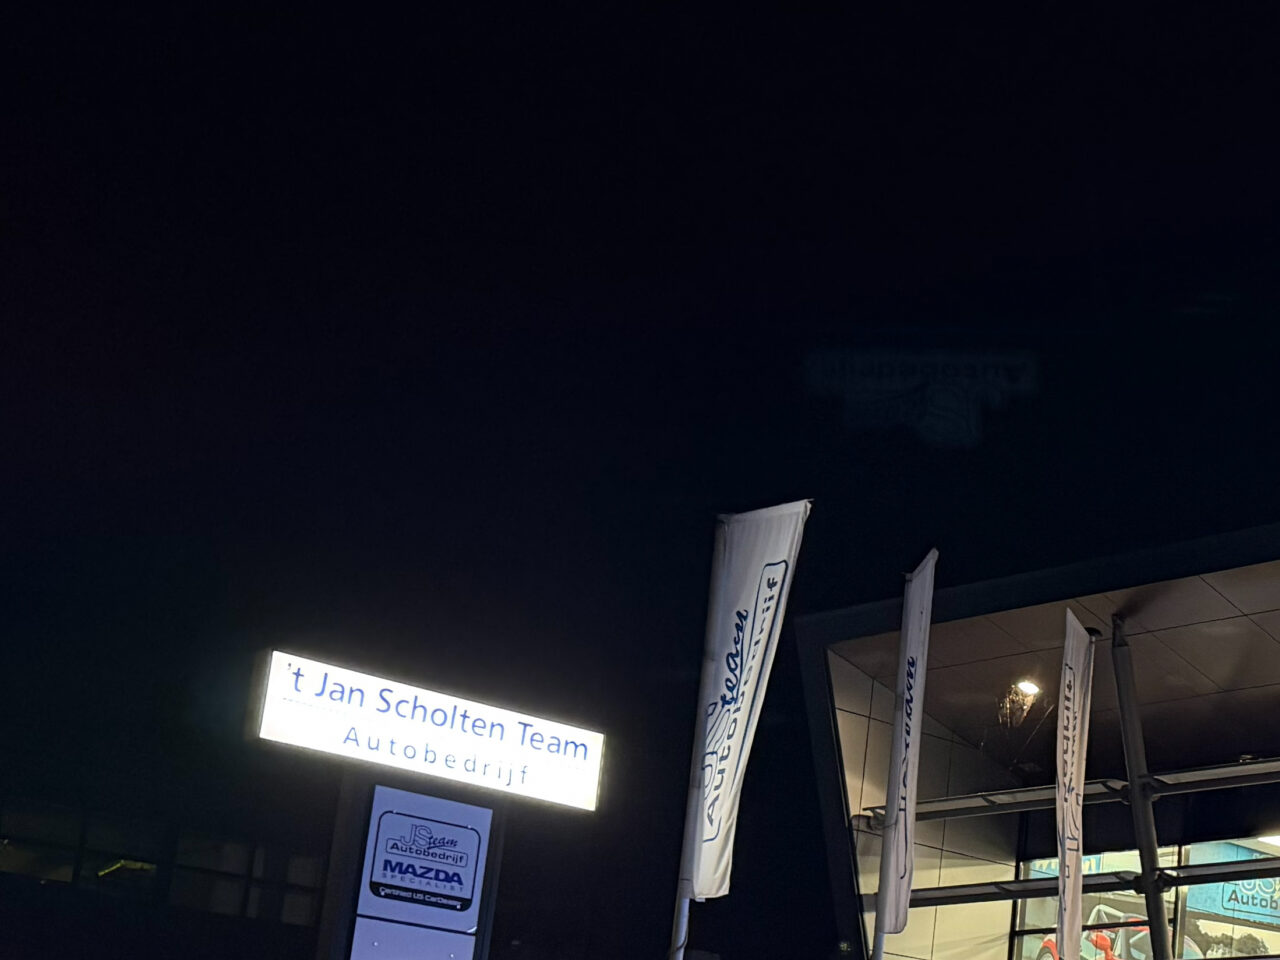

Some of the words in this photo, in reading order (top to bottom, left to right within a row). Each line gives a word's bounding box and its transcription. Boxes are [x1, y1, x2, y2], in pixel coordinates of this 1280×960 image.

[314, 672, 365, 708] Jan
[376, 688, 505, 741] Scholten
[517, 721, 588, 761] Team
[343, 727, 529, 787] Autobedrijf
[390, 842, 465, 865] Autobedrijf
[382, 859, 464, 886] MAZDA
[382, 873, 465, 893] SPECIALIST
